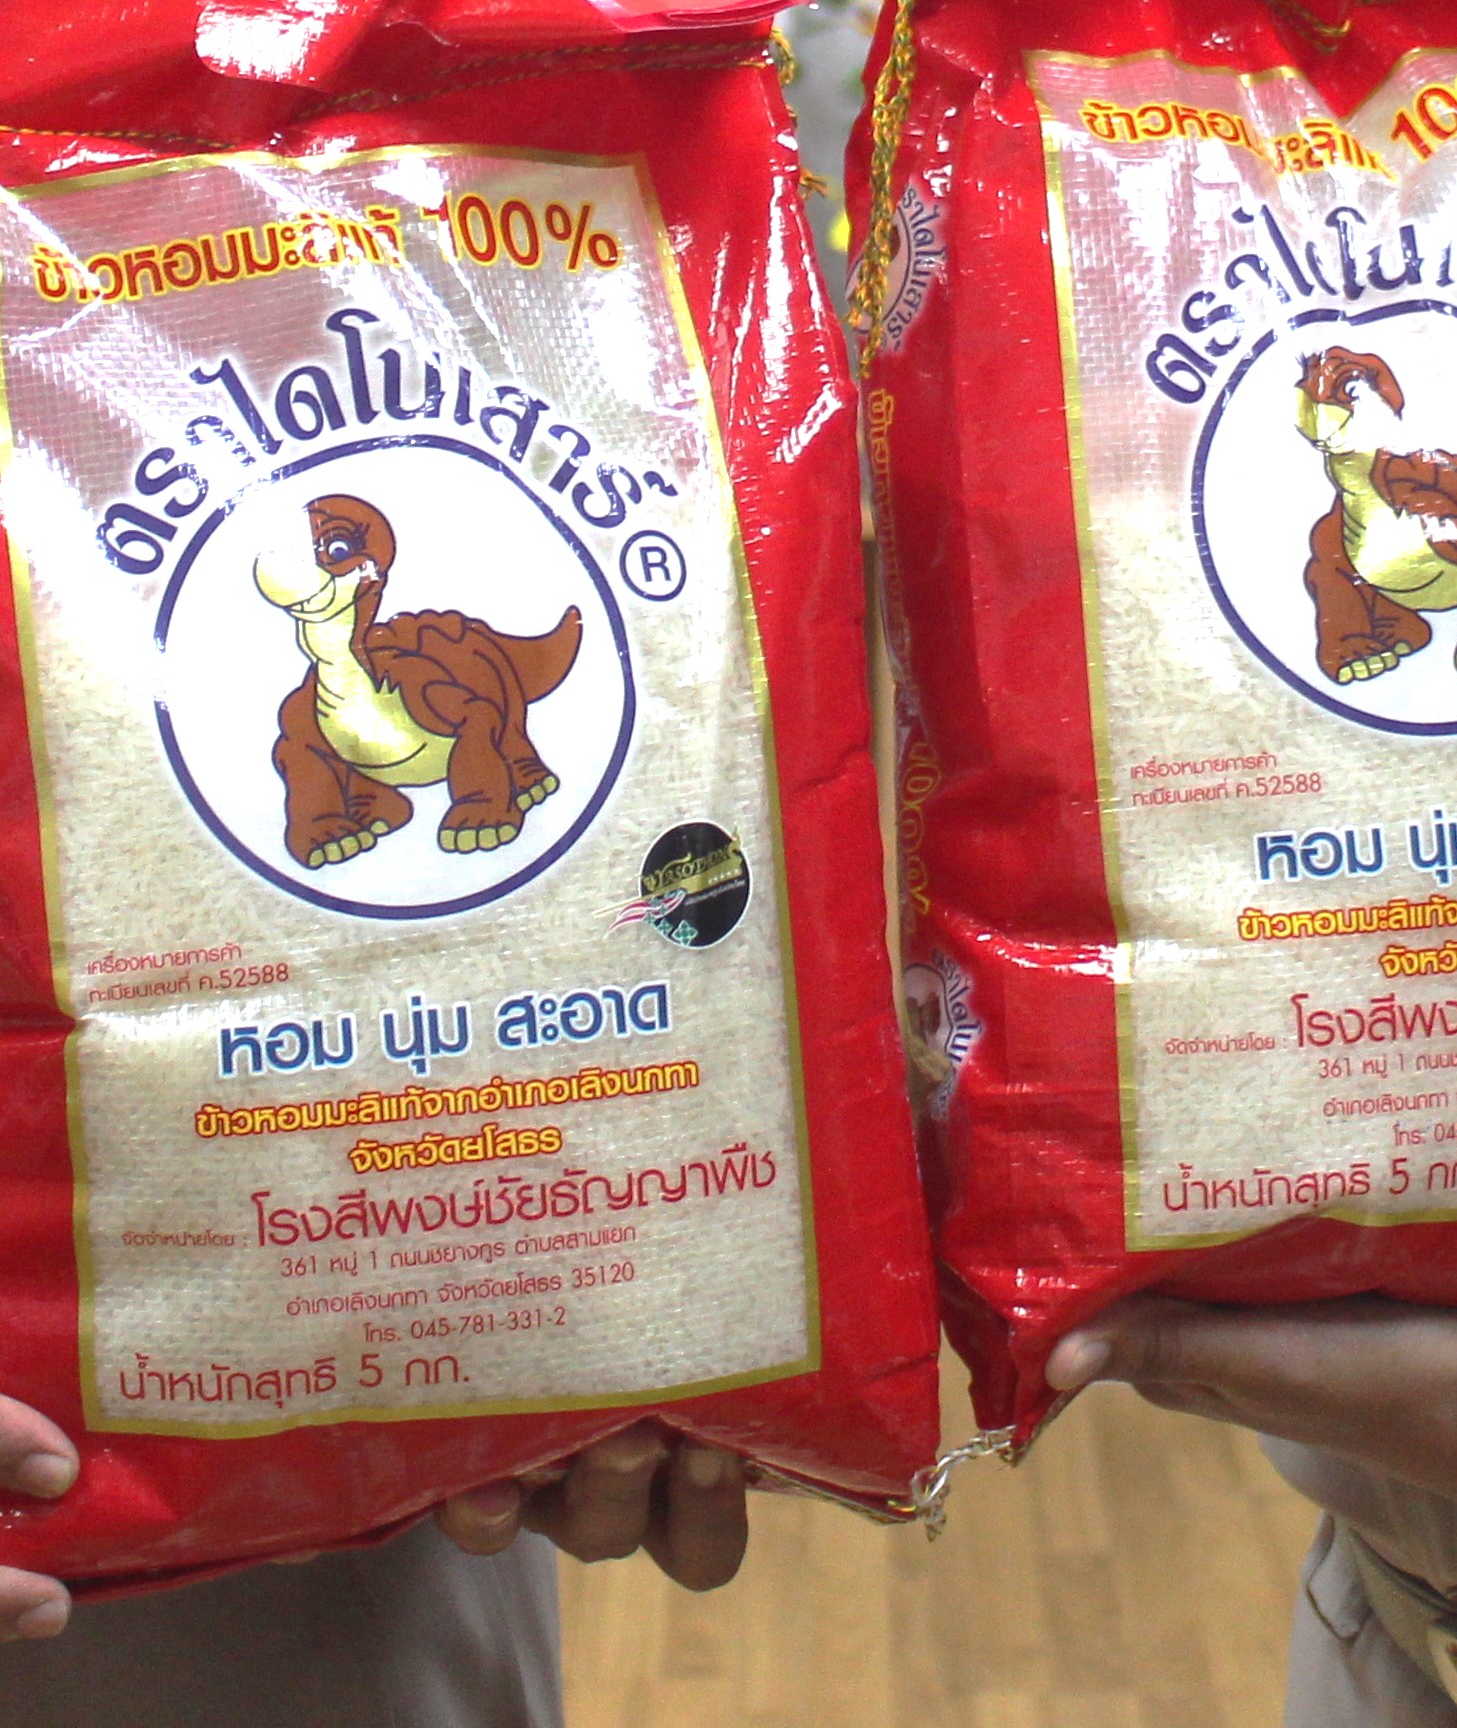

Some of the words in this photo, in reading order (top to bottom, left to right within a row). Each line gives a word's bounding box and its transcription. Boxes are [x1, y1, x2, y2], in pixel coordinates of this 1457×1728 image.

[1079, 98, 1397, 182] ข้าวหอะลิแ
[421, 191, 620, 272] 100%
[886, 184, 949, 352] ราไดโนเสาร์
[96, 308, 678, 576] ตราไดโนเสาร์
[1236, 772, 1322, 798] ค.52588
[1255, 824, 1385, 881] หอม
[199, 962, 289, 990] ค.52588
[219, 1012, 352, 1074] หอม
[382, 994, 469, 1074] นุ่ม
[496, 981, 671, 1050] สะอาด
[1318, 1056, 1352, 1079] 361
[1362, 1054, 1388, 1079] หมู่
[1398, 1052, 1405, 1072] 1
[194, 1060, 700, 1139] ข้าวหอมมะลิแท้จากอำเภอเลิงนกทา
[1322, 1090, 1448, 1117] อำเภอเลิงนกทา
[347, 1122, 563, 1175] จังหวัดยโสธร
[251, 1142, 777, 1247] โรงสีพงษ์ชัยธัญญาพืช
[1163, 1162, 1370, 1211] น้ำหนักสุทธิ
[1389, 1158, 1410, 1195] 5
[281, 1255, 317, 1278] 361
[330, 1251, 358, 1277] หมู่
[369, 1251, 378, 1270] 1
[390, 1239, 505, 1269] ถนนชยางกูร
[515, 1226, 636, 1255] ตำบลสามแยก
[286, 1288, 427, 1317] อำเภอเลิงนกทา
[438, 1272, 562, 1303] จังหวัดยโสธร
[572, 1261, 635, 1289] 35120
[364, 1322, 401, 1344] โทร.
[411, 1305, 566, 1340] 045-781-331-2
[120, 1352, 338, 1410] น้ำหนักสุทธิ
[359, 1353, 383, 1388] 5
[405, 1355, 470, 1387] กก.
